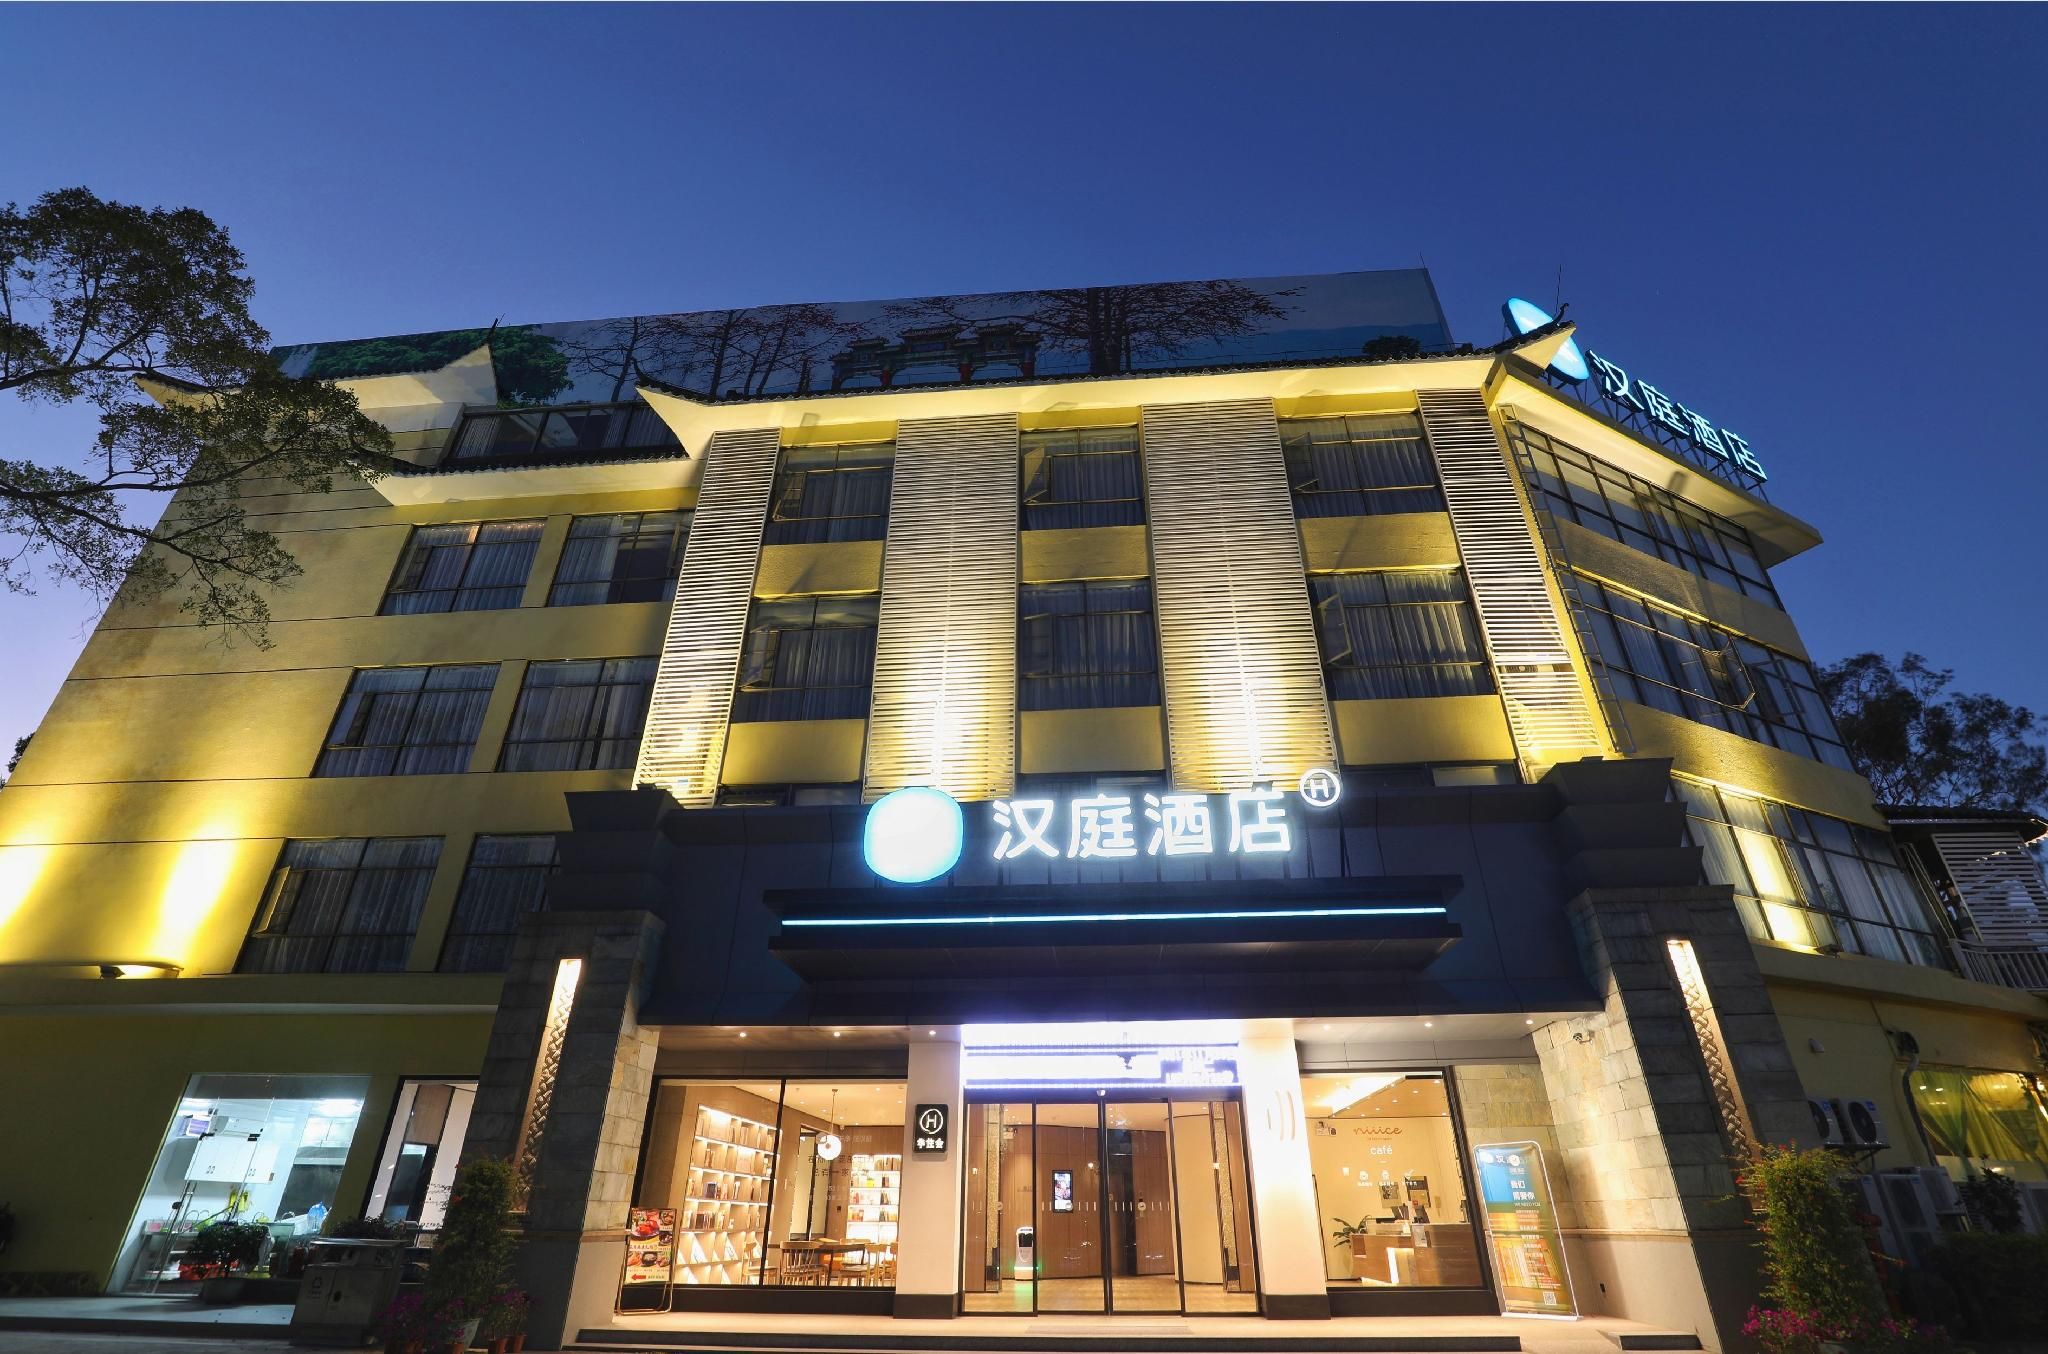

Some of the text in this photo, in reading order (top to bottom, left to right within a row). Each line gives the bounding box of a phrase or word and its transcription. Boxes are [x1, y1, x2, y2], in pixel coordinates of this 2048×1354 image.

[1586, 349, 1768, 482] 汉庭酒店
[993, 787, 1291, 861] 汉庭酒店
[916, 1137, 944, 1149] 华住会
[1370, 1145, 1393, 1155] café
